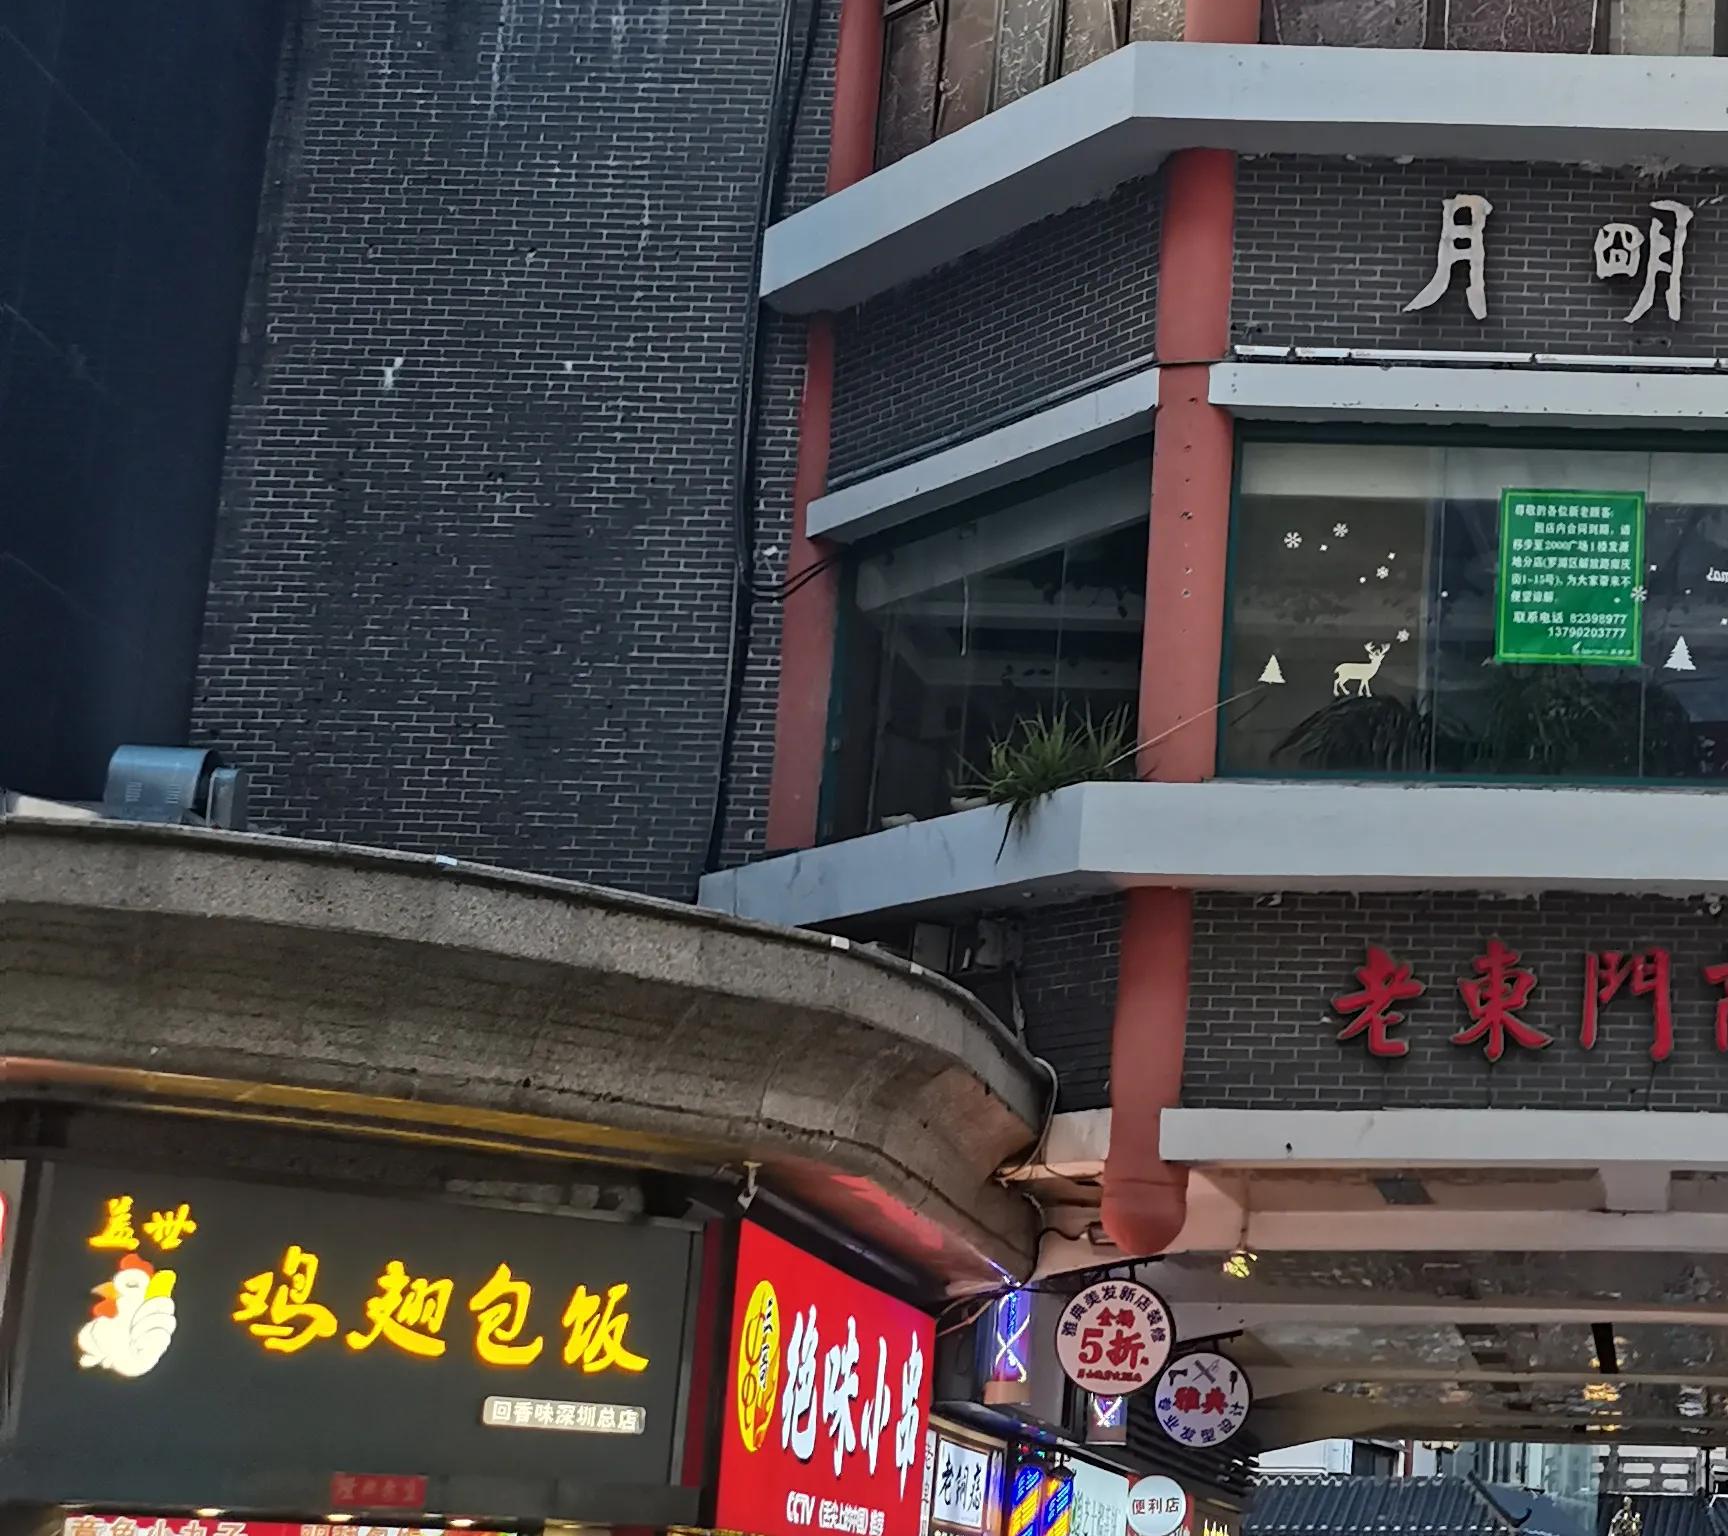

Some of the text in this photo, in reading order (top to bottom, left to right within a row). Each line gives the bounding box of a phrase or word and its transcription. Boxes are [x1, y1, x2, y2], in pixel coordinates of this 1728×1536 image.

[1547, 627, 1627, 638] 13790203777
[1569, 613, 1628, 625] 82398977
[88, 1195, 198, 1250] 盖世
[232, 1245, 649, 1373] 鸡翅包饭
[490, 1399, 640, 1432] 回香味深圳总店
[781, 1303, 924, 1502] 绝味小串
[1173, 1386, 1228, 1415] 雅典
[786, 1490, 816, 1526] CCTV
[1132, 1498, 1179, 1515] 便利店
